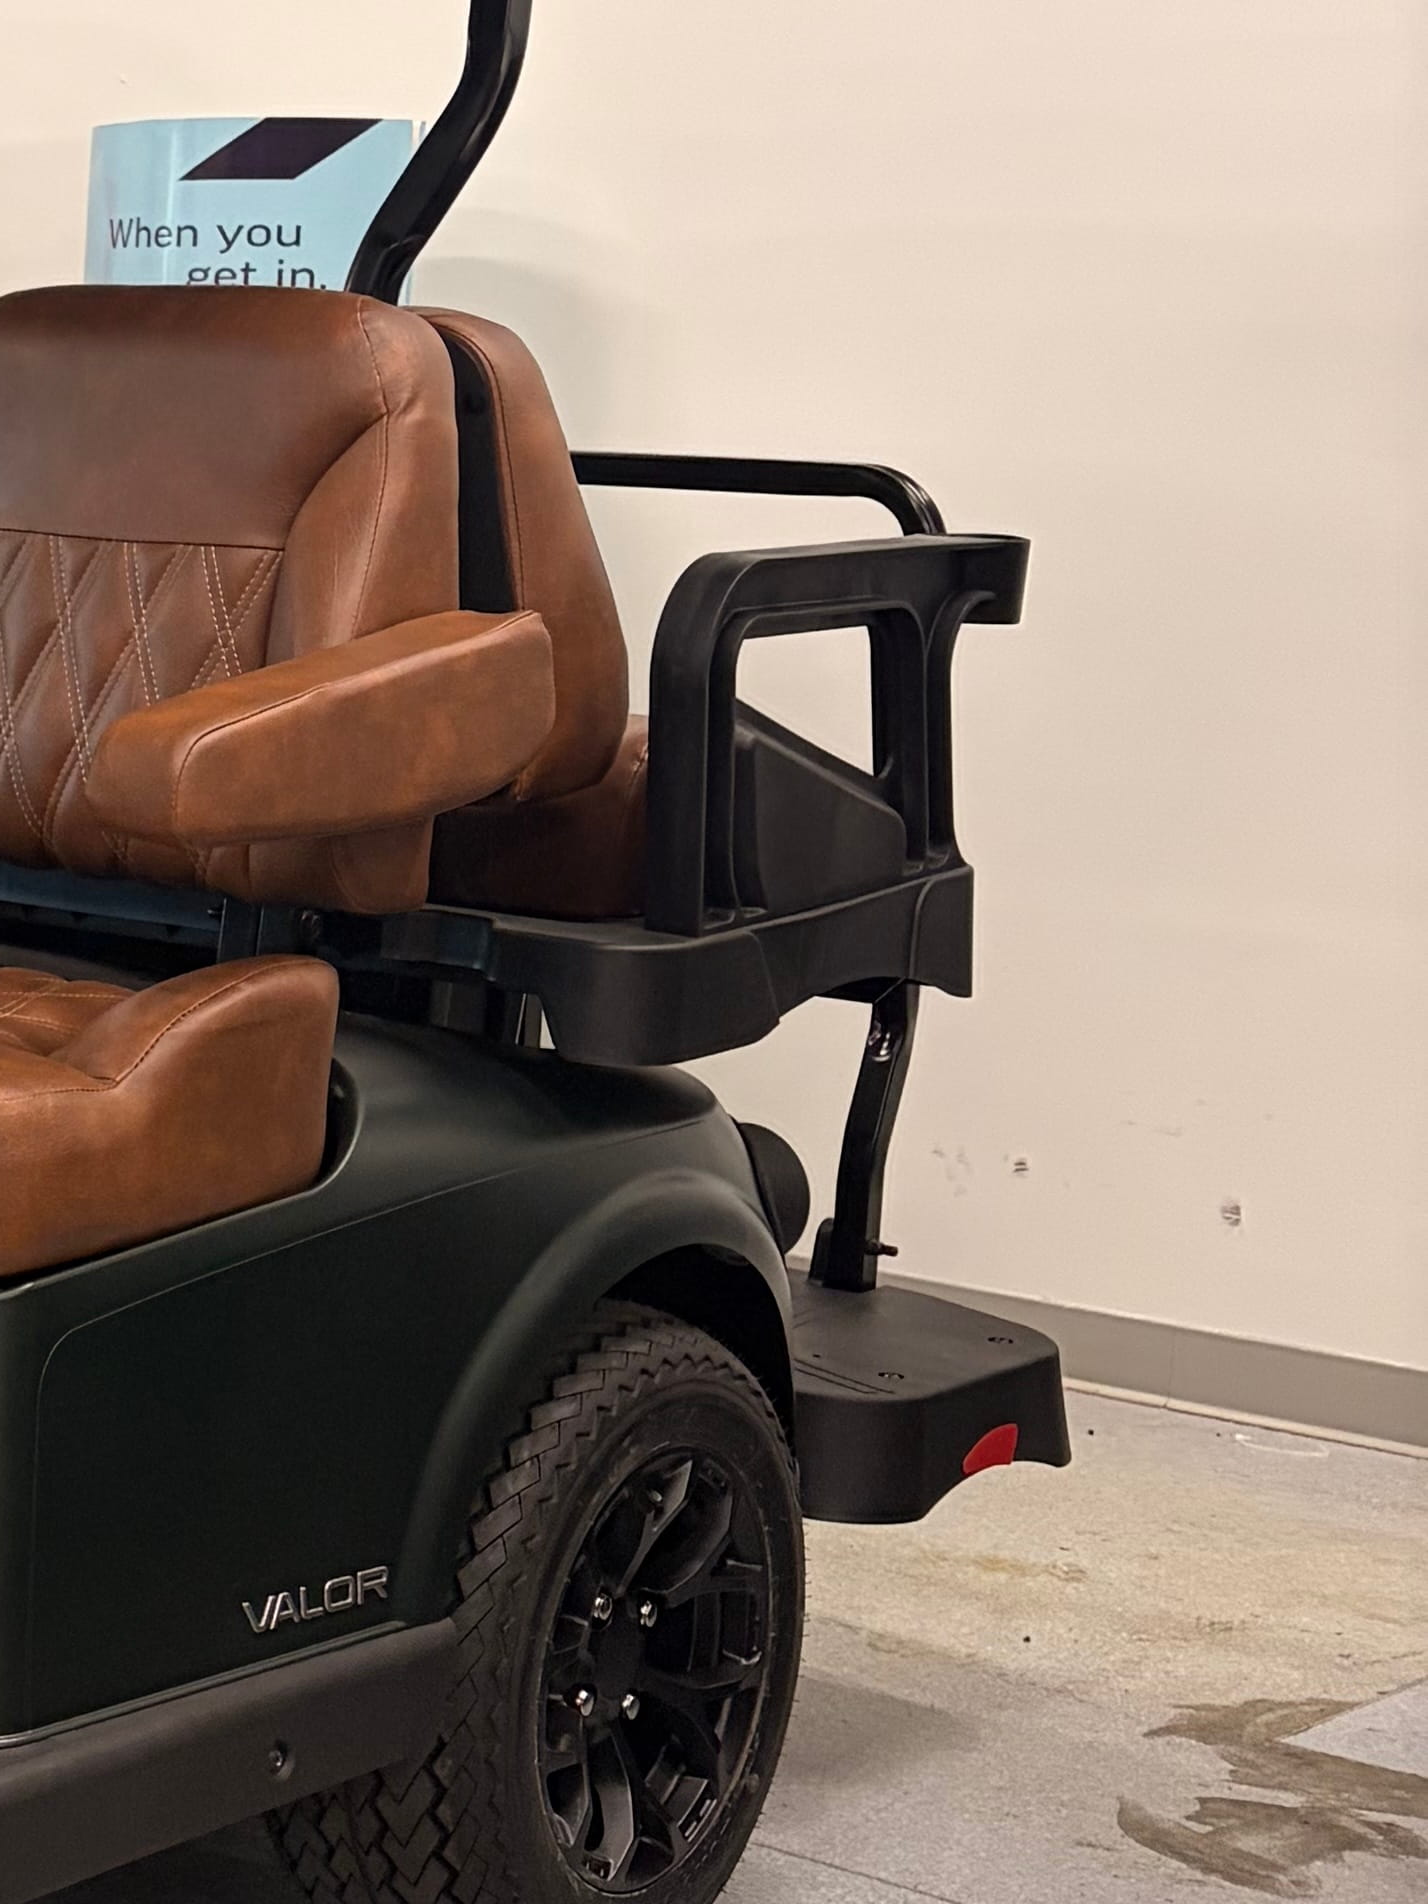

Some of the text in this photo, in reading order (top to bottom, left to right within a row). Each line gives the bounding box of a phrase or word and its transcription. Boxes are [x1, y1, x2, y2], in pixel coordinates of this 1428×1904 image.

[109, 217, 302, 254] When you
[186, 262, 257, 287] get
[241, 1564, 389, 1634] VALOR
